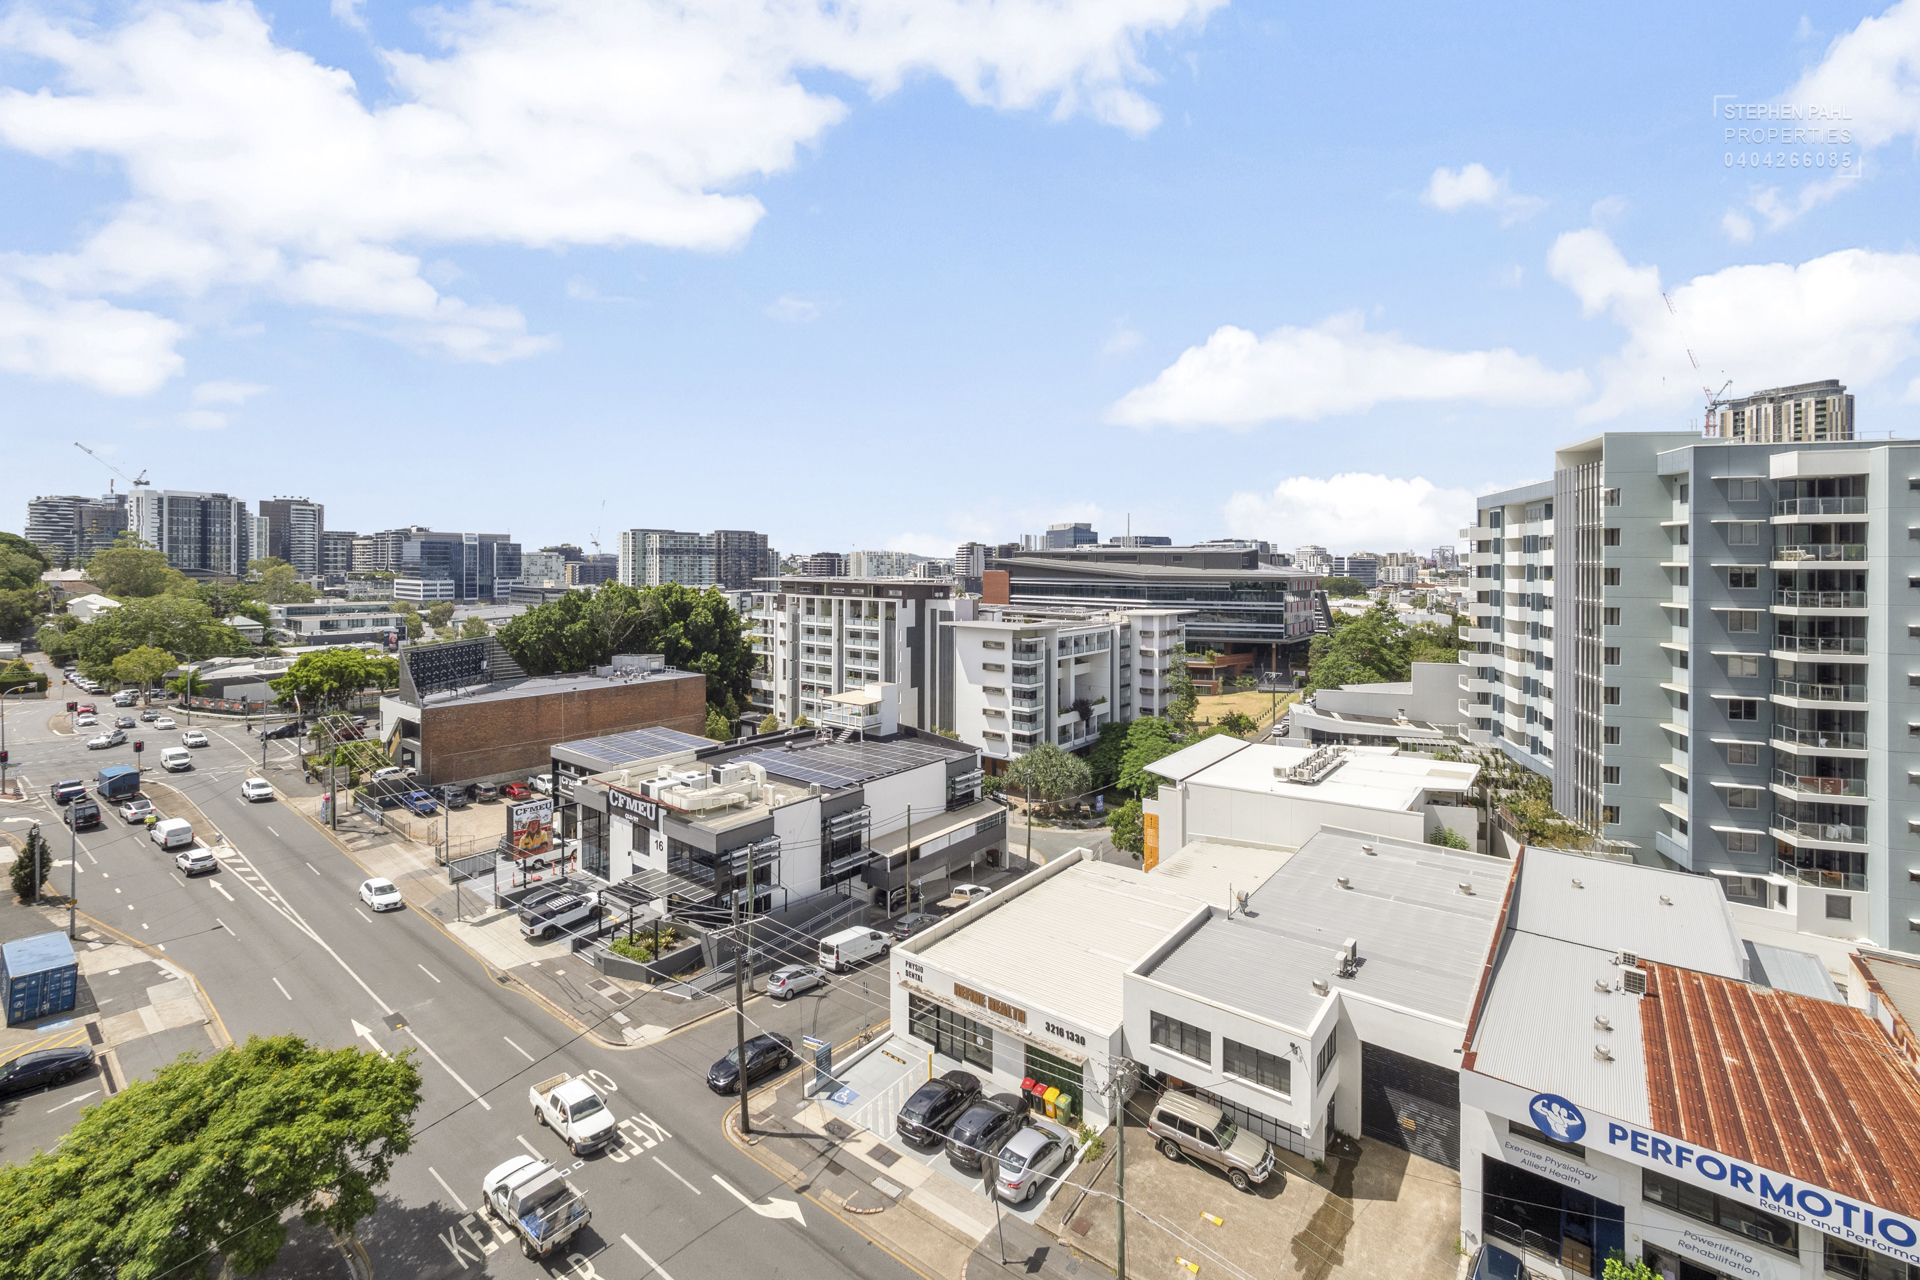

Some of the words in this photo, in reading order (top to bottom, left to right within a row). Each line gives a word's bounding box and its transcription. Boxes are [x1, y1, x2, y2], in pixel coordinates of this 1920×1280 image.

[515, 801, 552, 816] CFMEU
[609, 788, 657, 821] CFMEU
[654, 839, 664, 851] 16
[905, 960, 923, 974] PHYSIO
[905, 969, 923, 983] DENTAL
[954, 982, 986, 1008] REFINE
[987, 996, 1026, 1024] HEALTH
[1045, 1021, 1065, 1038] 3216
[1065, 1030, 1086, 1046] 1330
[1504, 1141, 1543, 1161] Exercise
[1544, 1156, 1598, 1181] Physiology
[1520, 1158, 1547, 1173] Allied
[1548, 1168, 1581, 1185] Health
[1759, 1198, 1807, 1222] Rehab
[1810, 1217, 1841, 1236] and
[1677, 1239, 1761, 1278] Rehabilitation
[1683, 1229, 1753, 1264] Powerlifting
